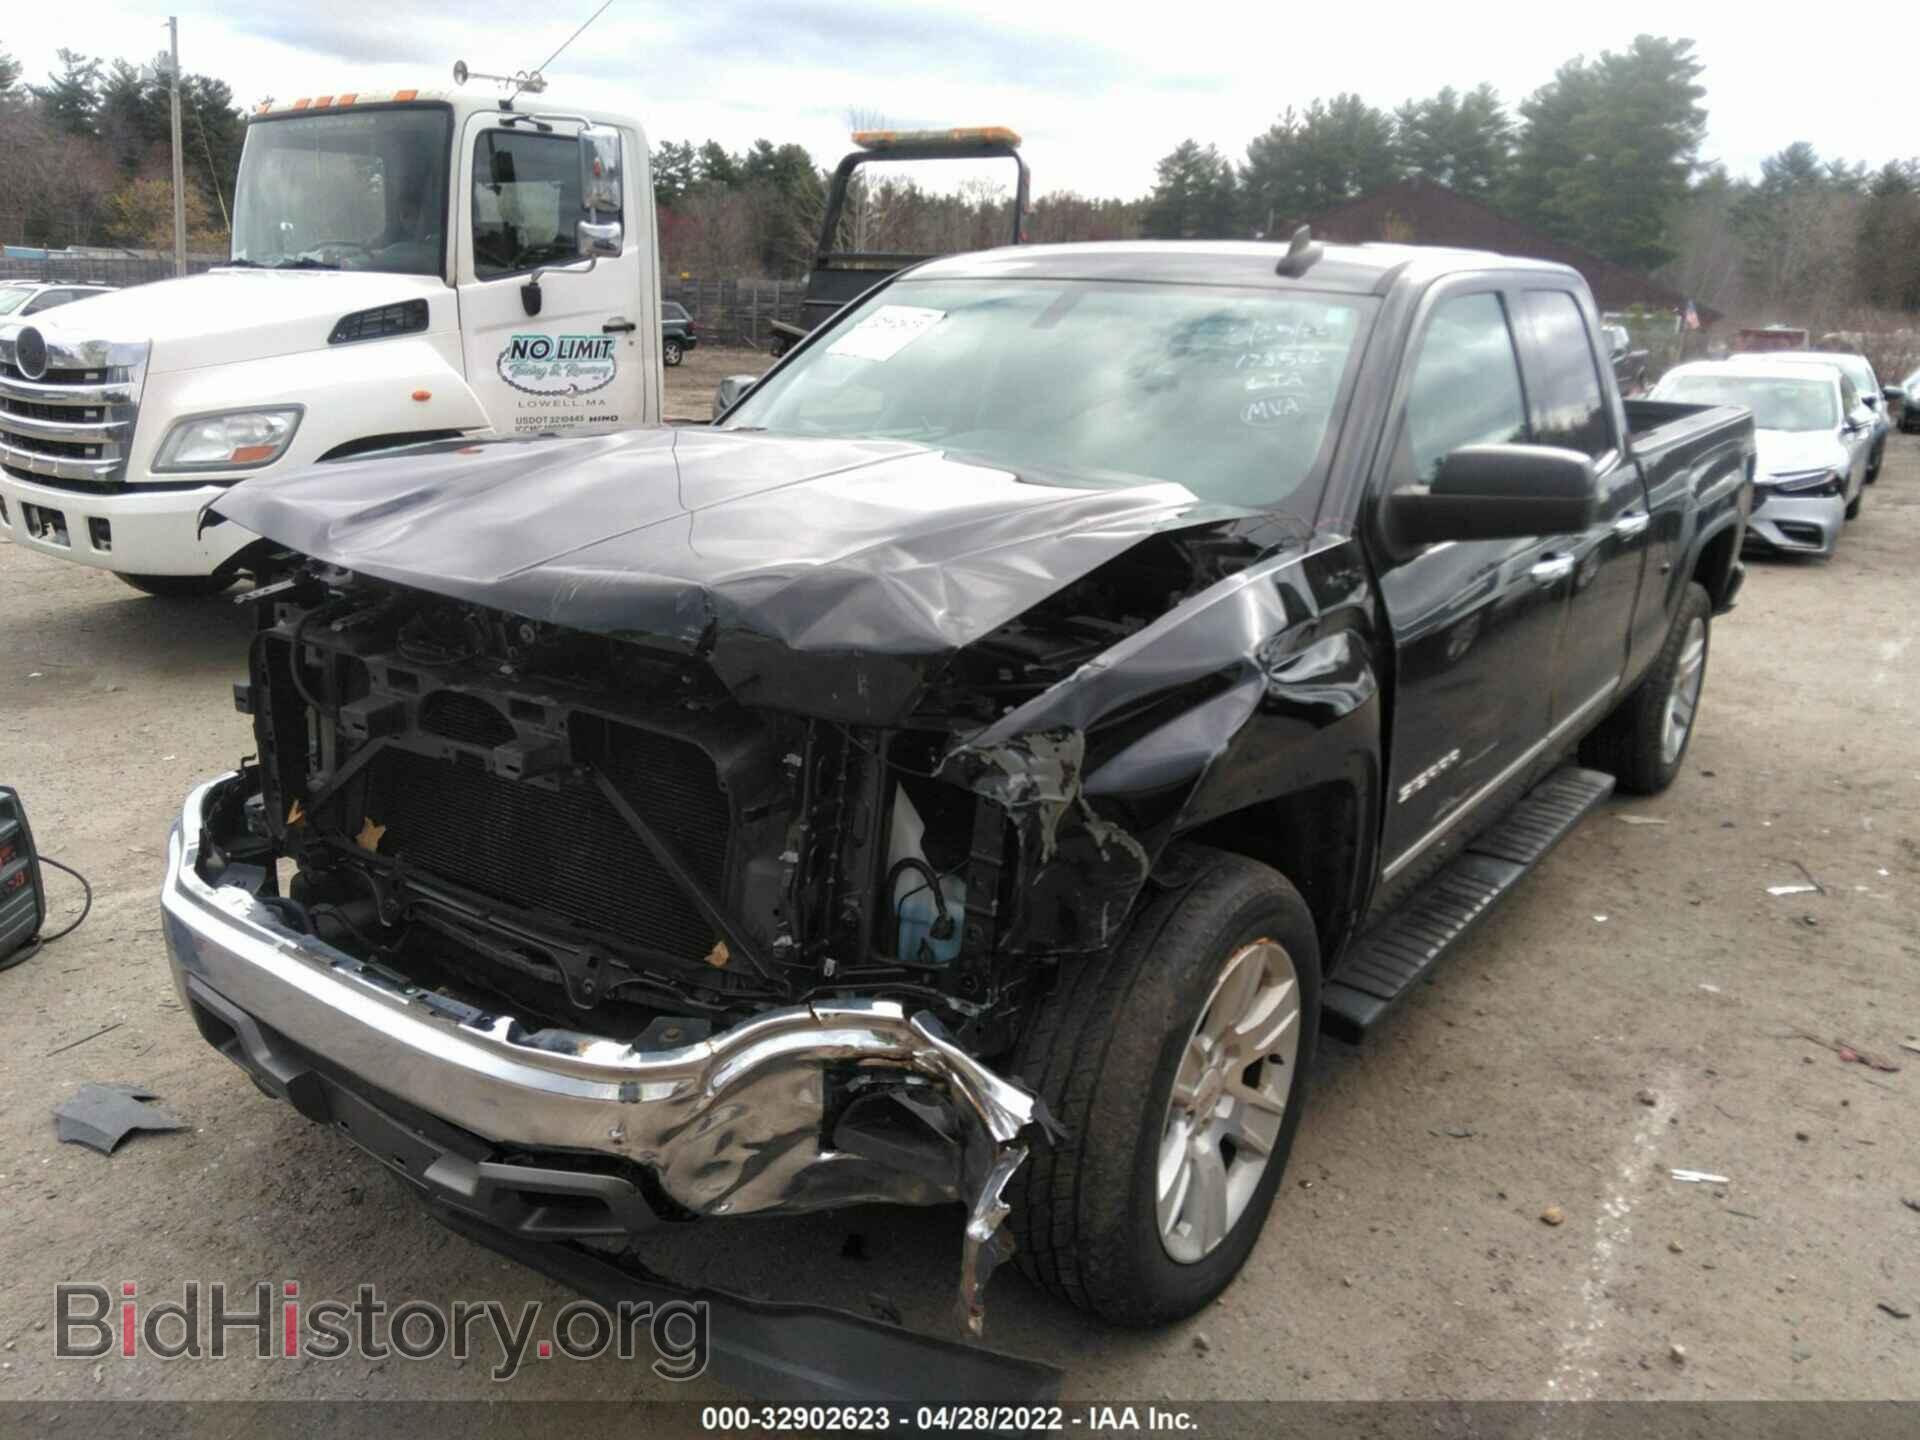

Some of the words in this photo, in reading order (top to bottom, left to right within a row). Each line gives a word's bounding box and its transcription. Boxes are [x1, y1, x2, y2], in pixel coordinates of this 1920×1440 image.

[511, 339, 551, 361] NO
[557, 339, 613, 361] LIMIT
[549, 363, 561, 377] &
[515, 416, 547, 425] USDOT
